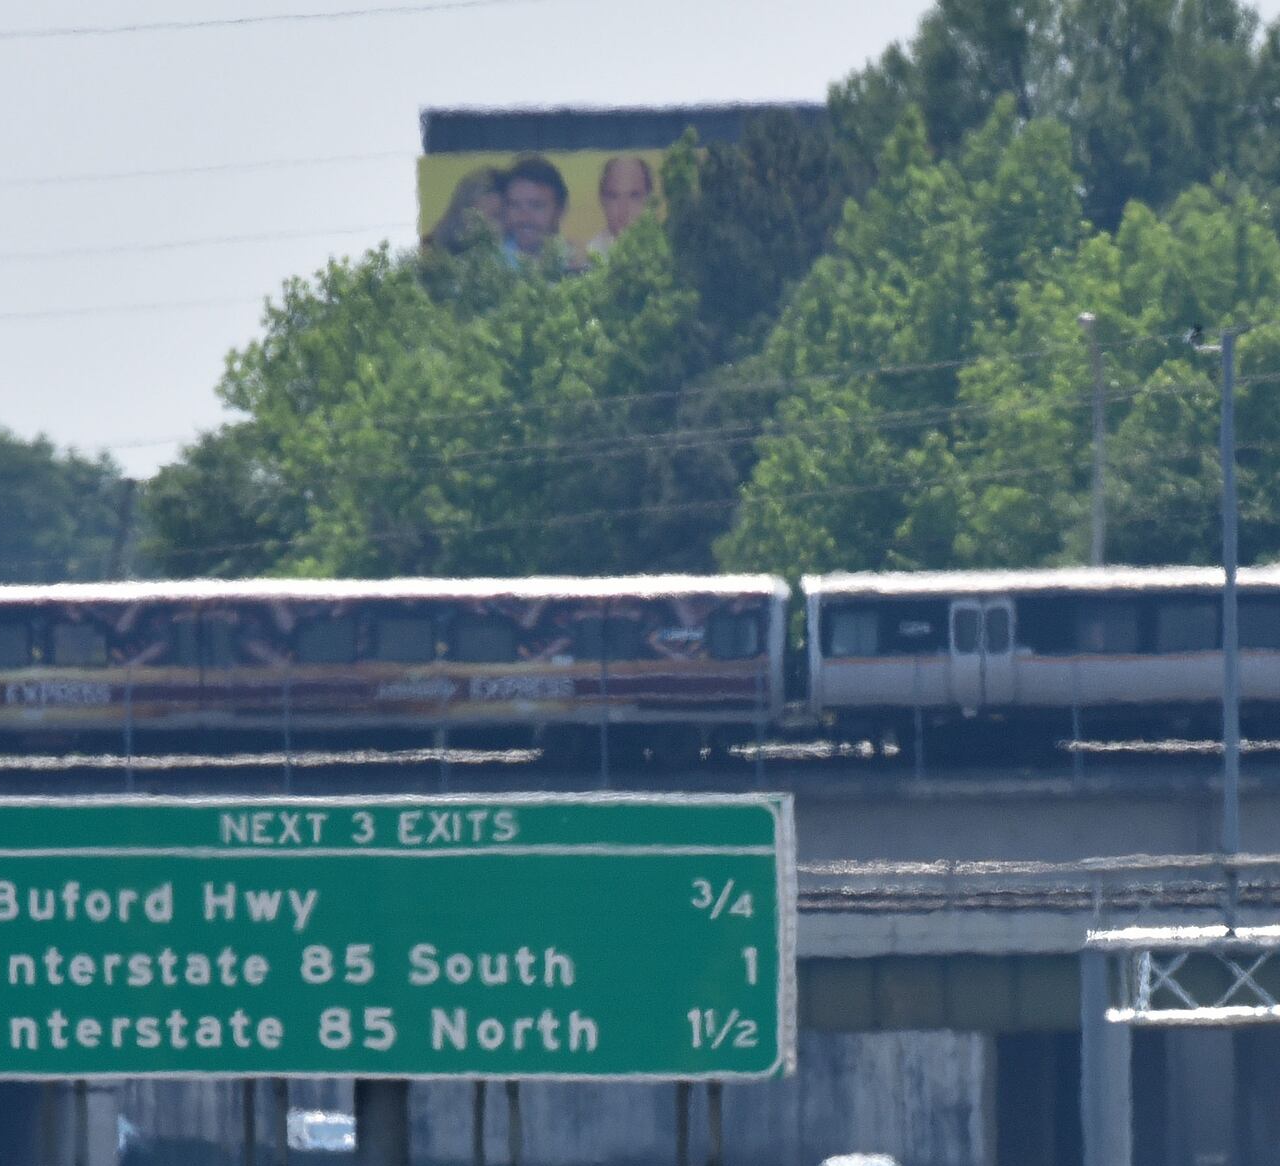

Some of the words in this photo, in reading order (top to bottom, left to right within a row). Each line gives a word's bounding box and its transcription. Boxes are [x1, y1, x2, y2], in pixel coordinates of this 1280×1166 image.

[220, 813, 325, 844] NEXT
[352, 811, 376, 843] 3
[398, 812, 518, 842] EXITS
[204, 882, 318, 931] Hwy
[301, 944, 374, 984] 85
[409, 944, 575, 987] South
[742, 946, 757, 984] 1
[319, 1007, 397, 1051] 85
[432, 1008, 598, 1051] North
